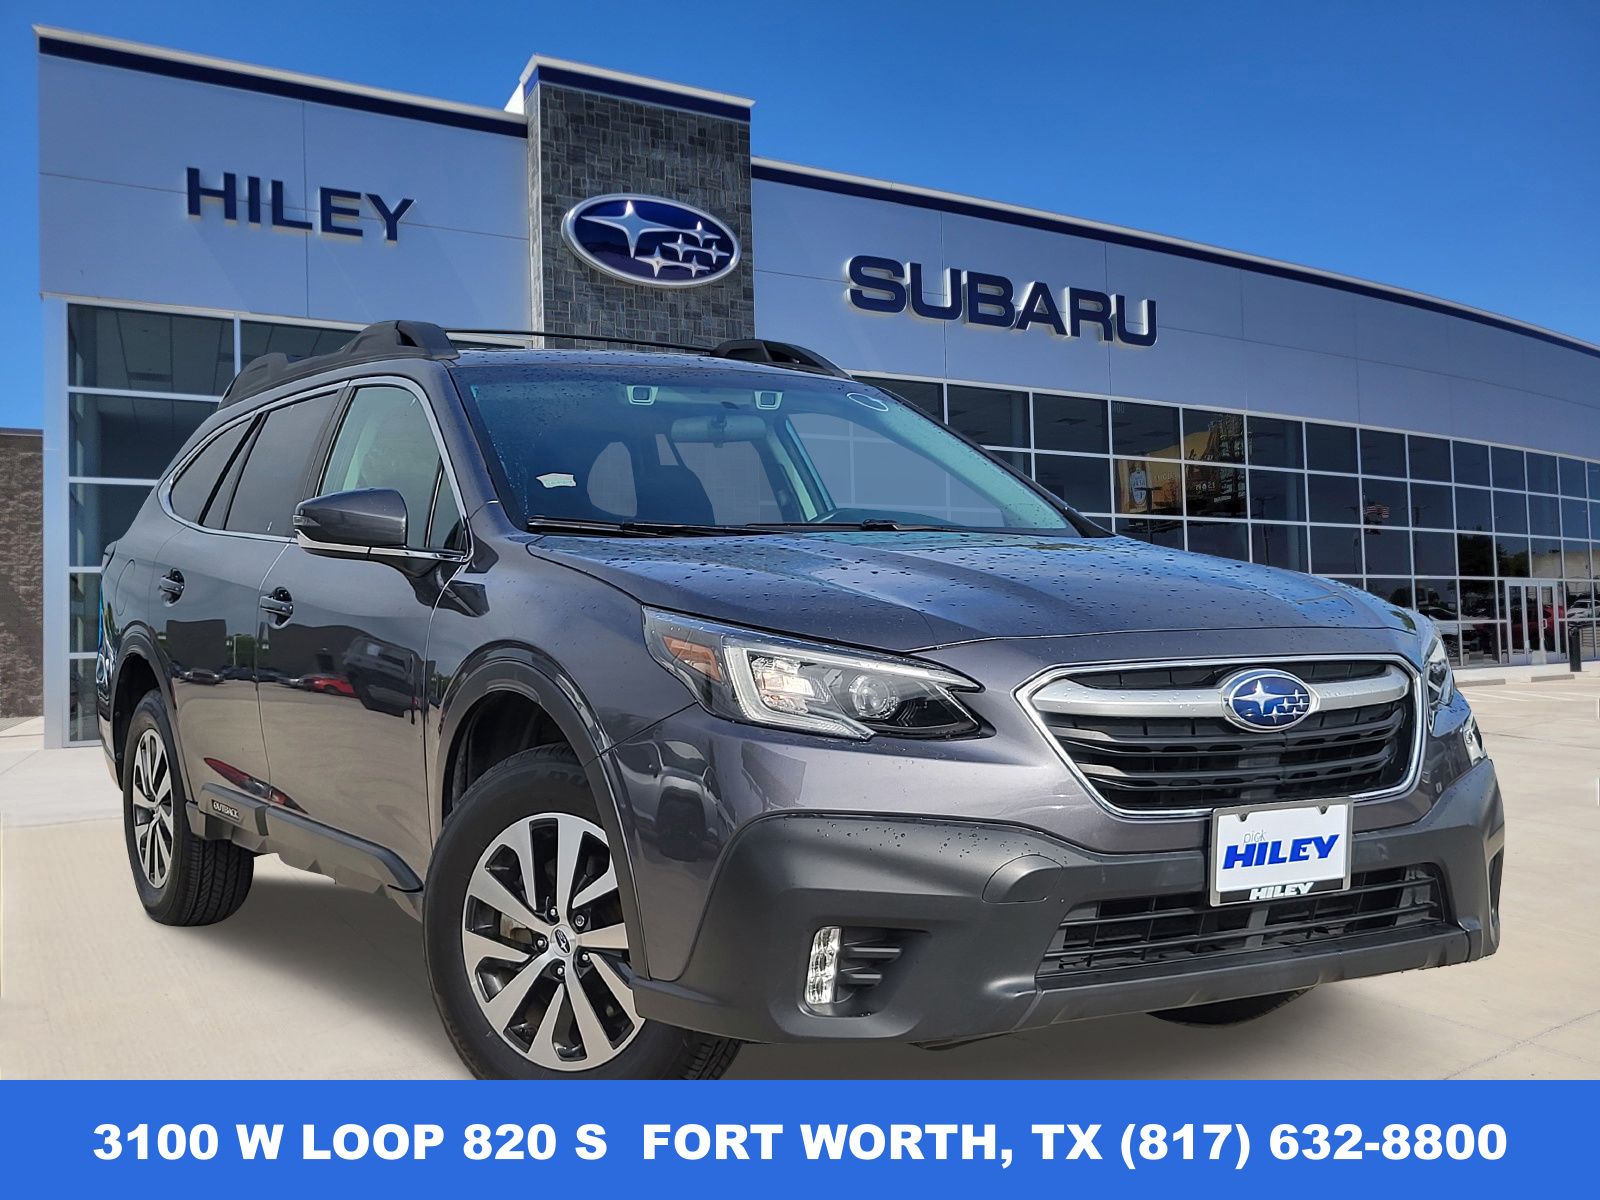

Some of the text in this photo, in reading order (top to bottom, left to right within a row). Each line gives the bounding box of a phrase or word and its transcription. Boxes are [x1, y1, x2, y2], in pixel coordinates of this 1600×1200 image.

[186, 167, 416, 242] HILEY
[847, 254, 1158, 347] SUBARU
[213, 801, 239, 819] OUTBACK
[1222, 834, 1339, 869] HILEY
[1249, 882, 1314, 900] HILEY
